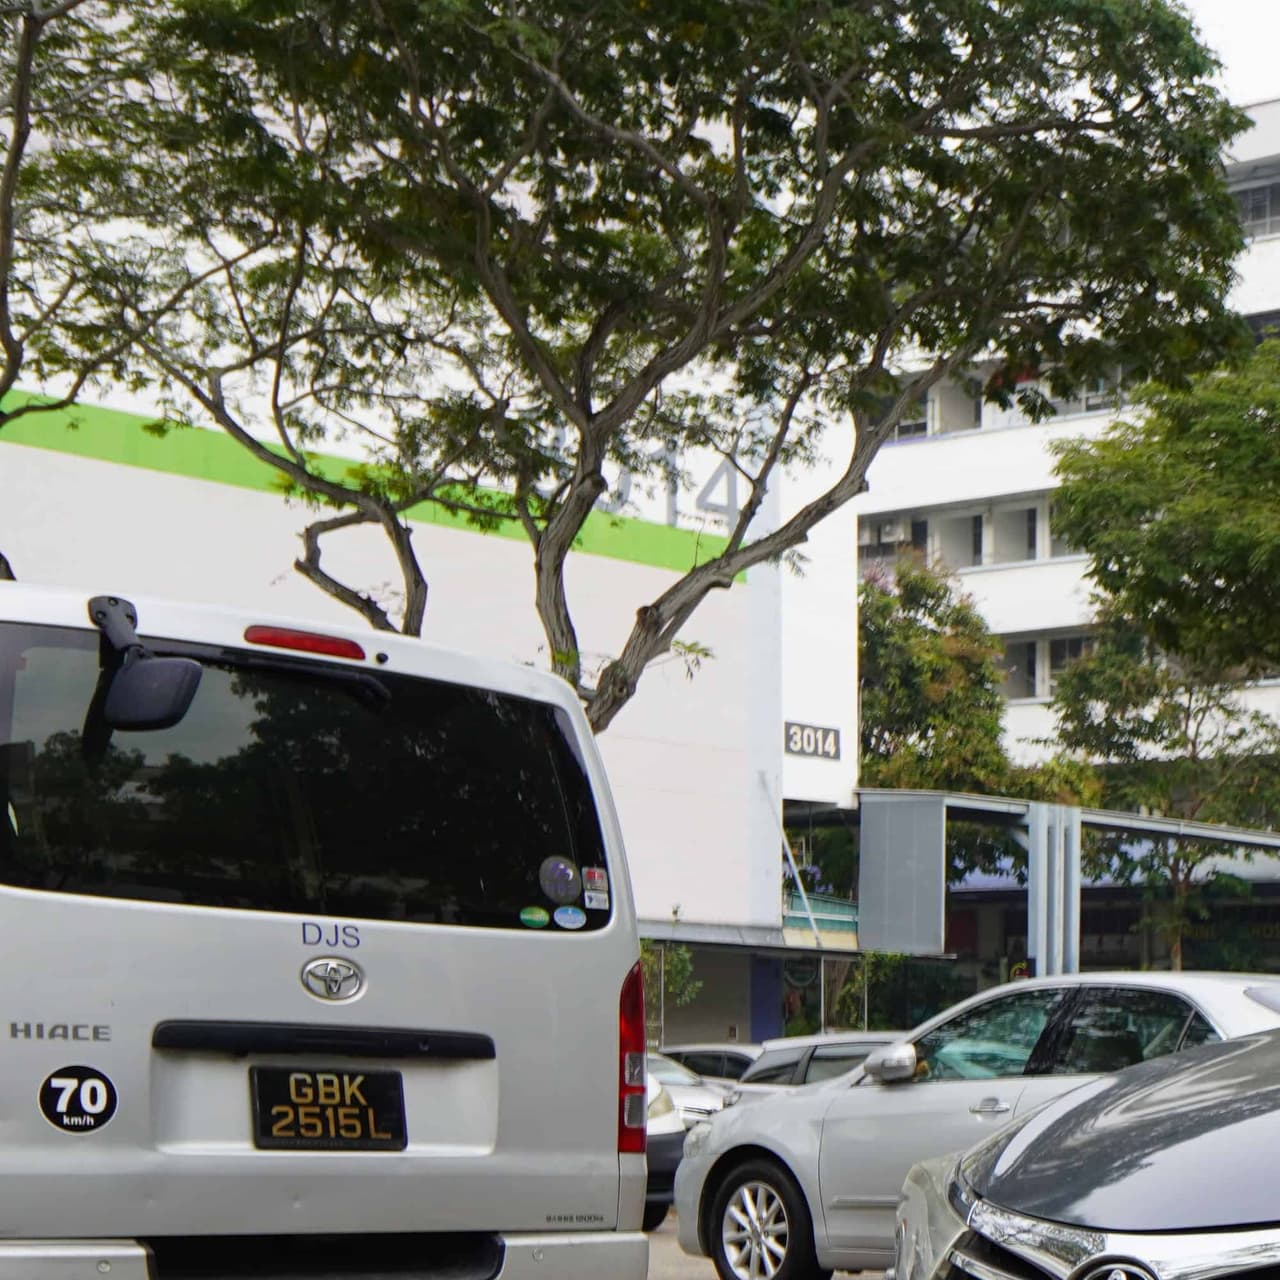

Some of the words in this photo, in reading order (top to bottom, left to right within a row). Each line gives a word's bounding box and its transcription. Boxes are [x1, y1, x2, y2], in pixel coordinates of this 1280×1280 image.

[789, 725, 837, 757] 3014
[302, 922, 361, 948] DJS
[9, 1022, 112, 1042] HIACE
[50, 1078, 108, 1114] 70
[289, 1072, 368, 1105] GBK
[63, 1114, 95, 1126] km/h
